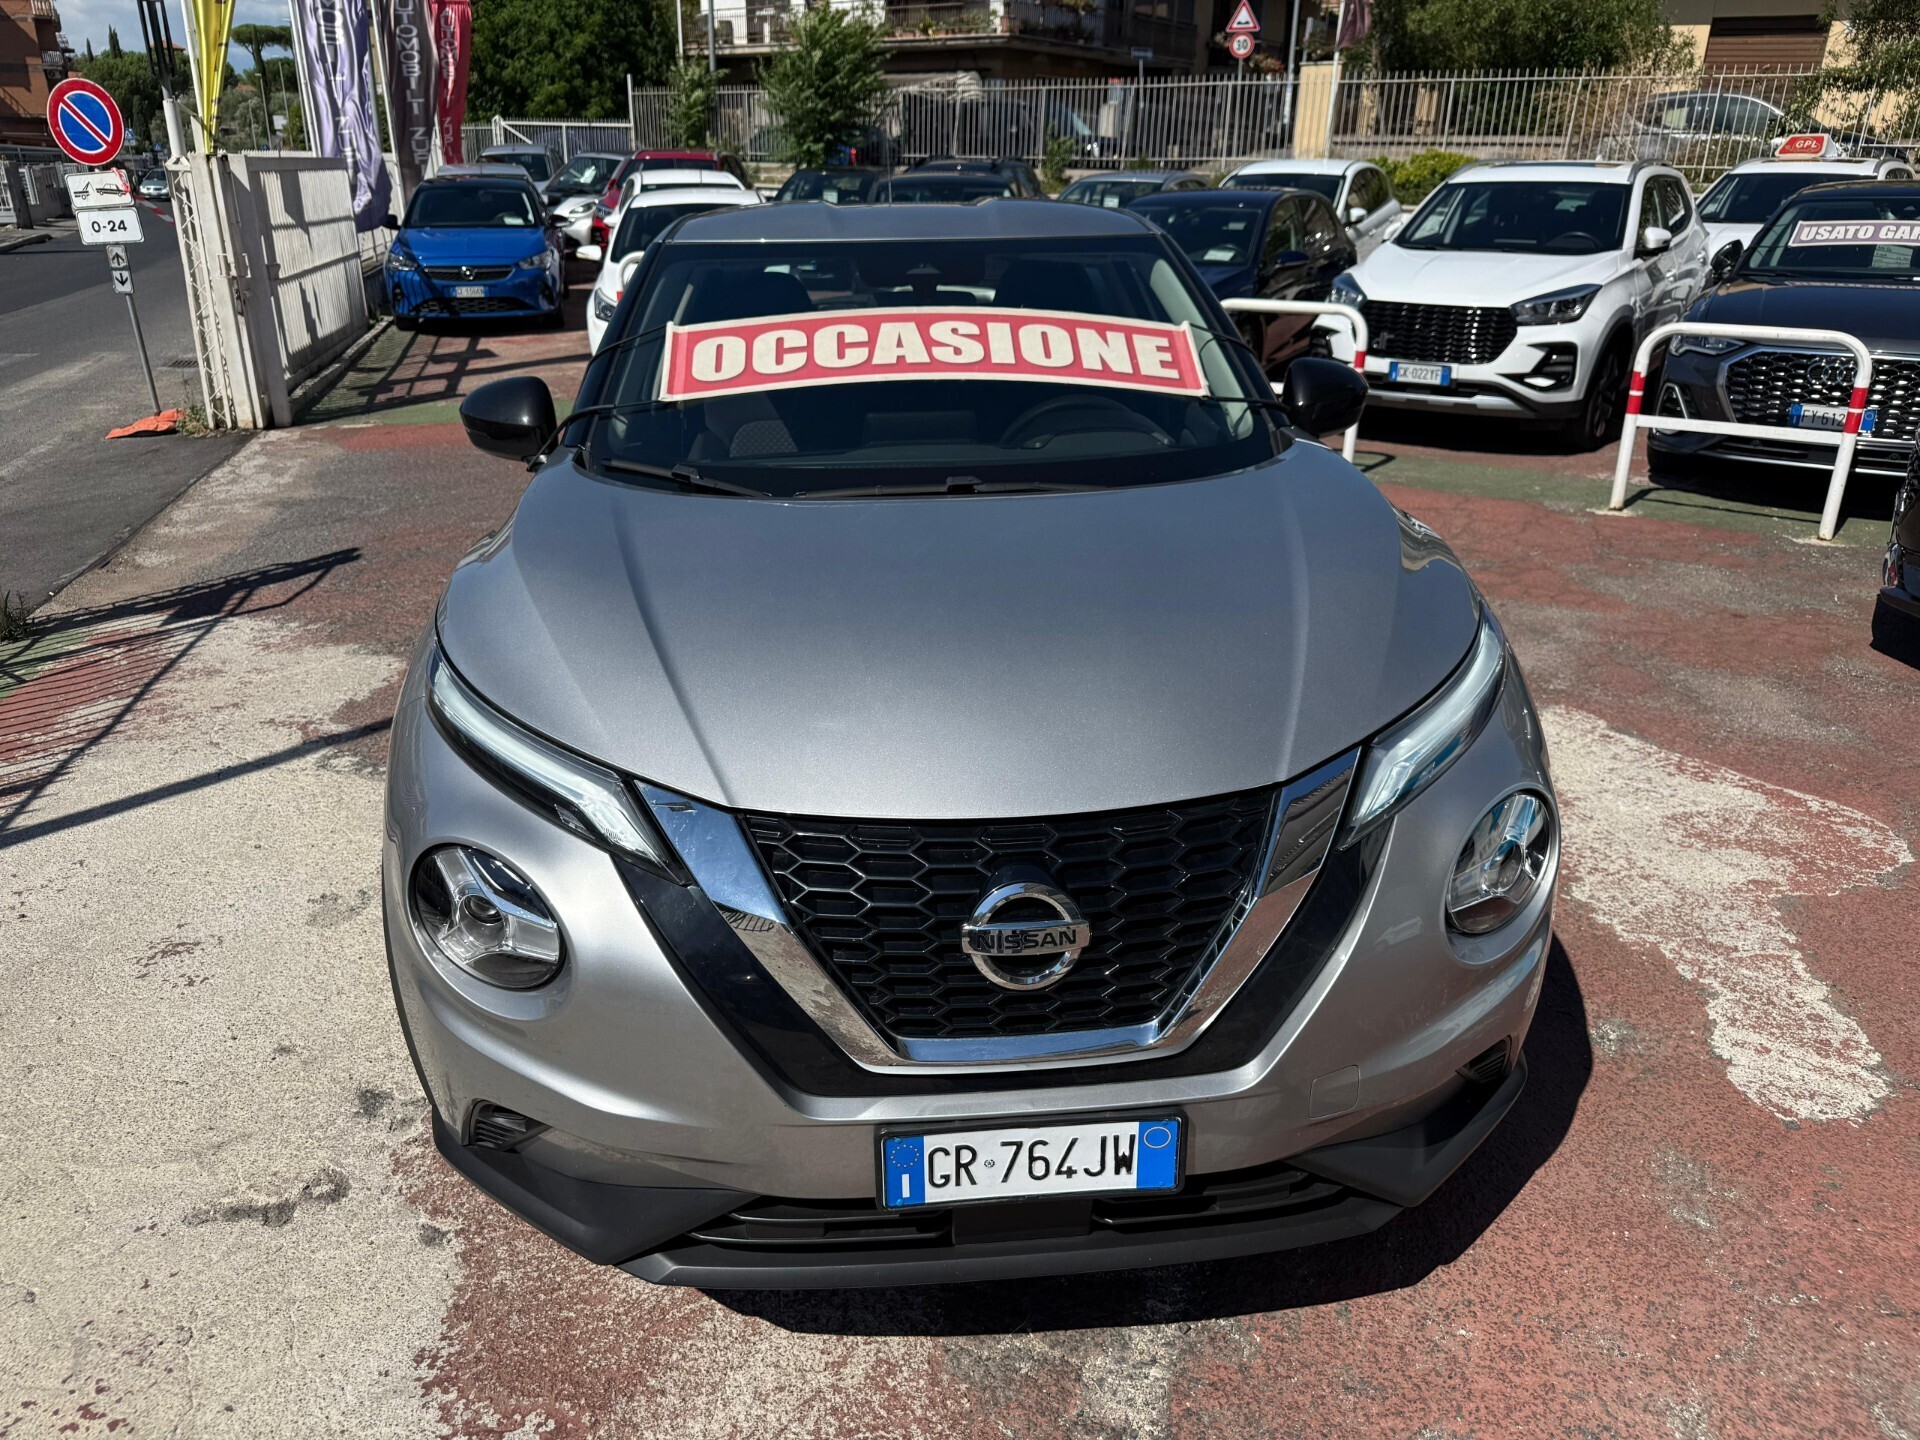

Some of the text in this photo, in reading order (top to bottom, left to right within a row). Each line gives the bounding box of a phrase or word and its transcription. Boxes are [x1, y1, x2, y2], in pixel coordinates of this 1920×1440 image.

[1236, 39, 1248, 50] 30
[1795, 139, 1818, 149] GPL
[91, 219, 128, 233] 0-24
[1799, 225, 1875, 241] USATO
[691, 320, 1181, 382] OCCASIONE
[1801, 409, 1819, 425] FY
[976, 929, 1077, 950] NISSAN
[927, 1144, 978, 1188] GR
[1000, 1133, 1136, 1184] 764JW
